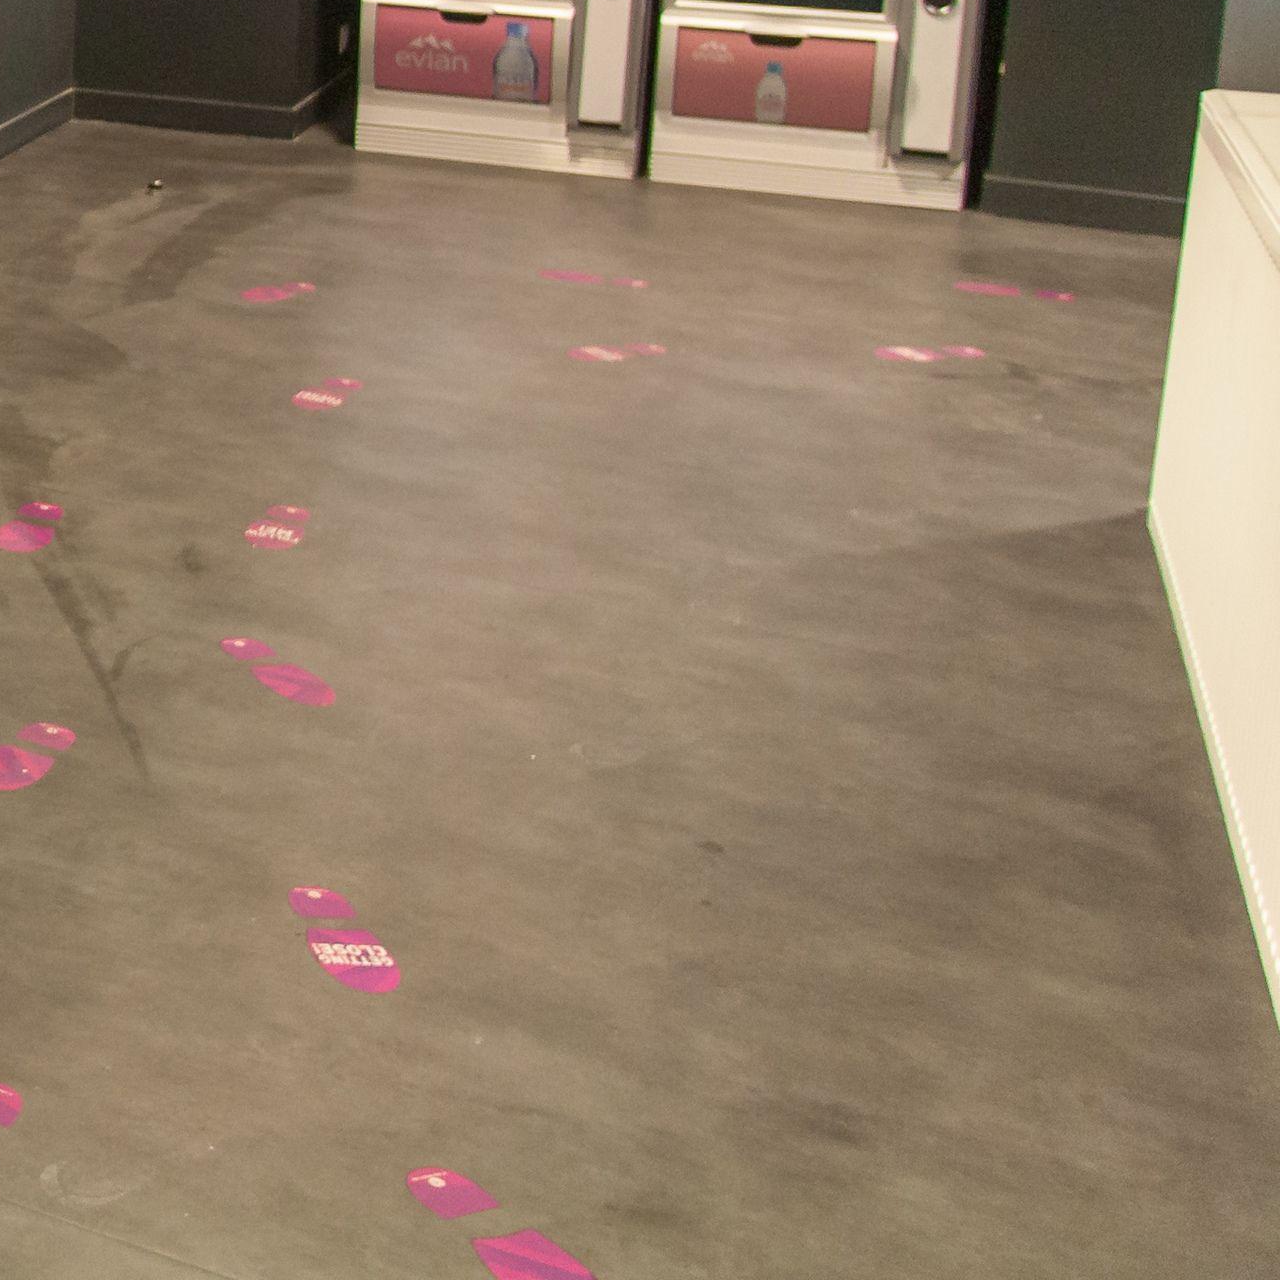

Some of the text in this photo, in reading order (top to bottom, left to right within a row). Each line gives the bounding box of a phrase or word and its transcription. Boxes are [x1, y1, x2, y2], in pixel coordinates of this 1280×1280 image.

[395, 49, 468, 74] evian
[311, 942, 388, 956] CLOSE!
[318, 953, 394, 968] GETTING
